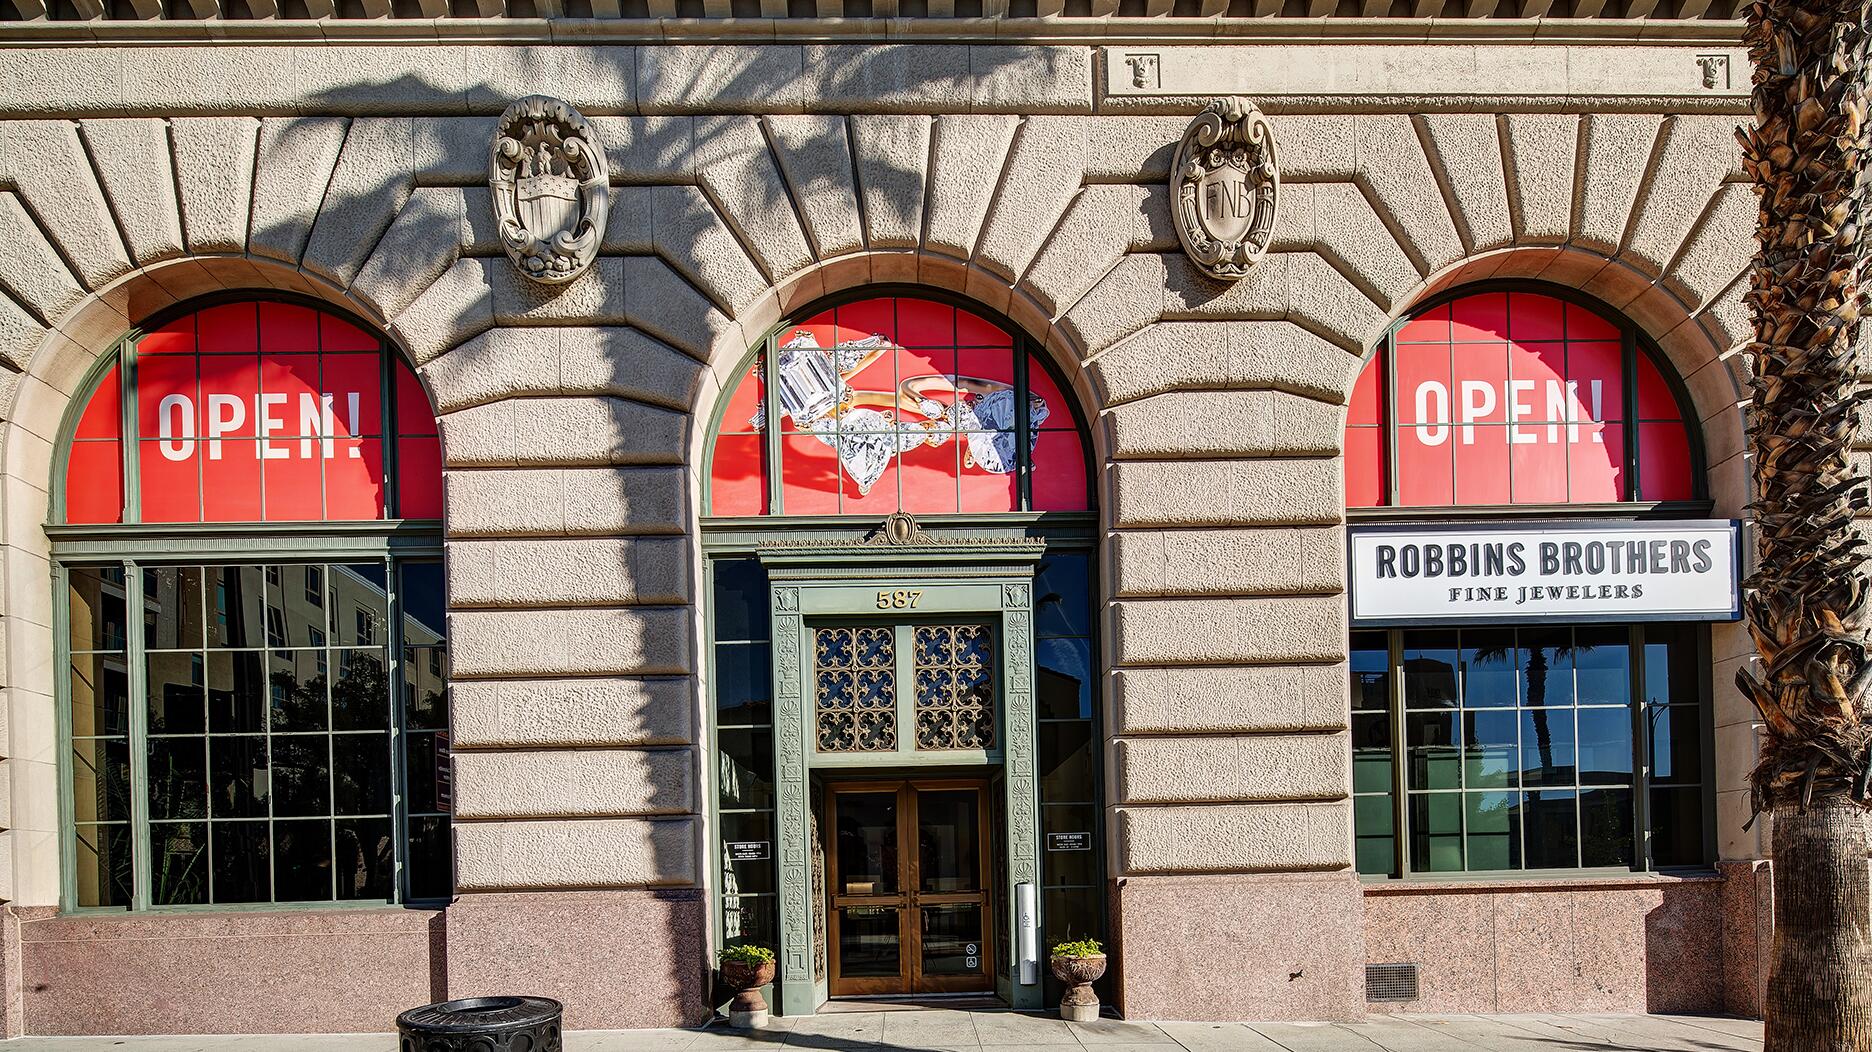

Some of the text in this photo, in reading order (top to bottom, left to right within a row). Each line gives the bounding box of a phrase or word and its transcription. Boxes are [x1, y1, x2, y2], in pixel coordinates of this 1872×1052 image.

[1206, 180, 1251, 220] FNB
[159, 392, 362, 462] OPEN!
[1415, 379, 1603, 446] OPEN!
[1376, 539, 1713, 579] ROBBINS BROTHERS
[876, 589, 924, 609] 587
[1448, 584, 1644, 605] FINE JEWELERS
